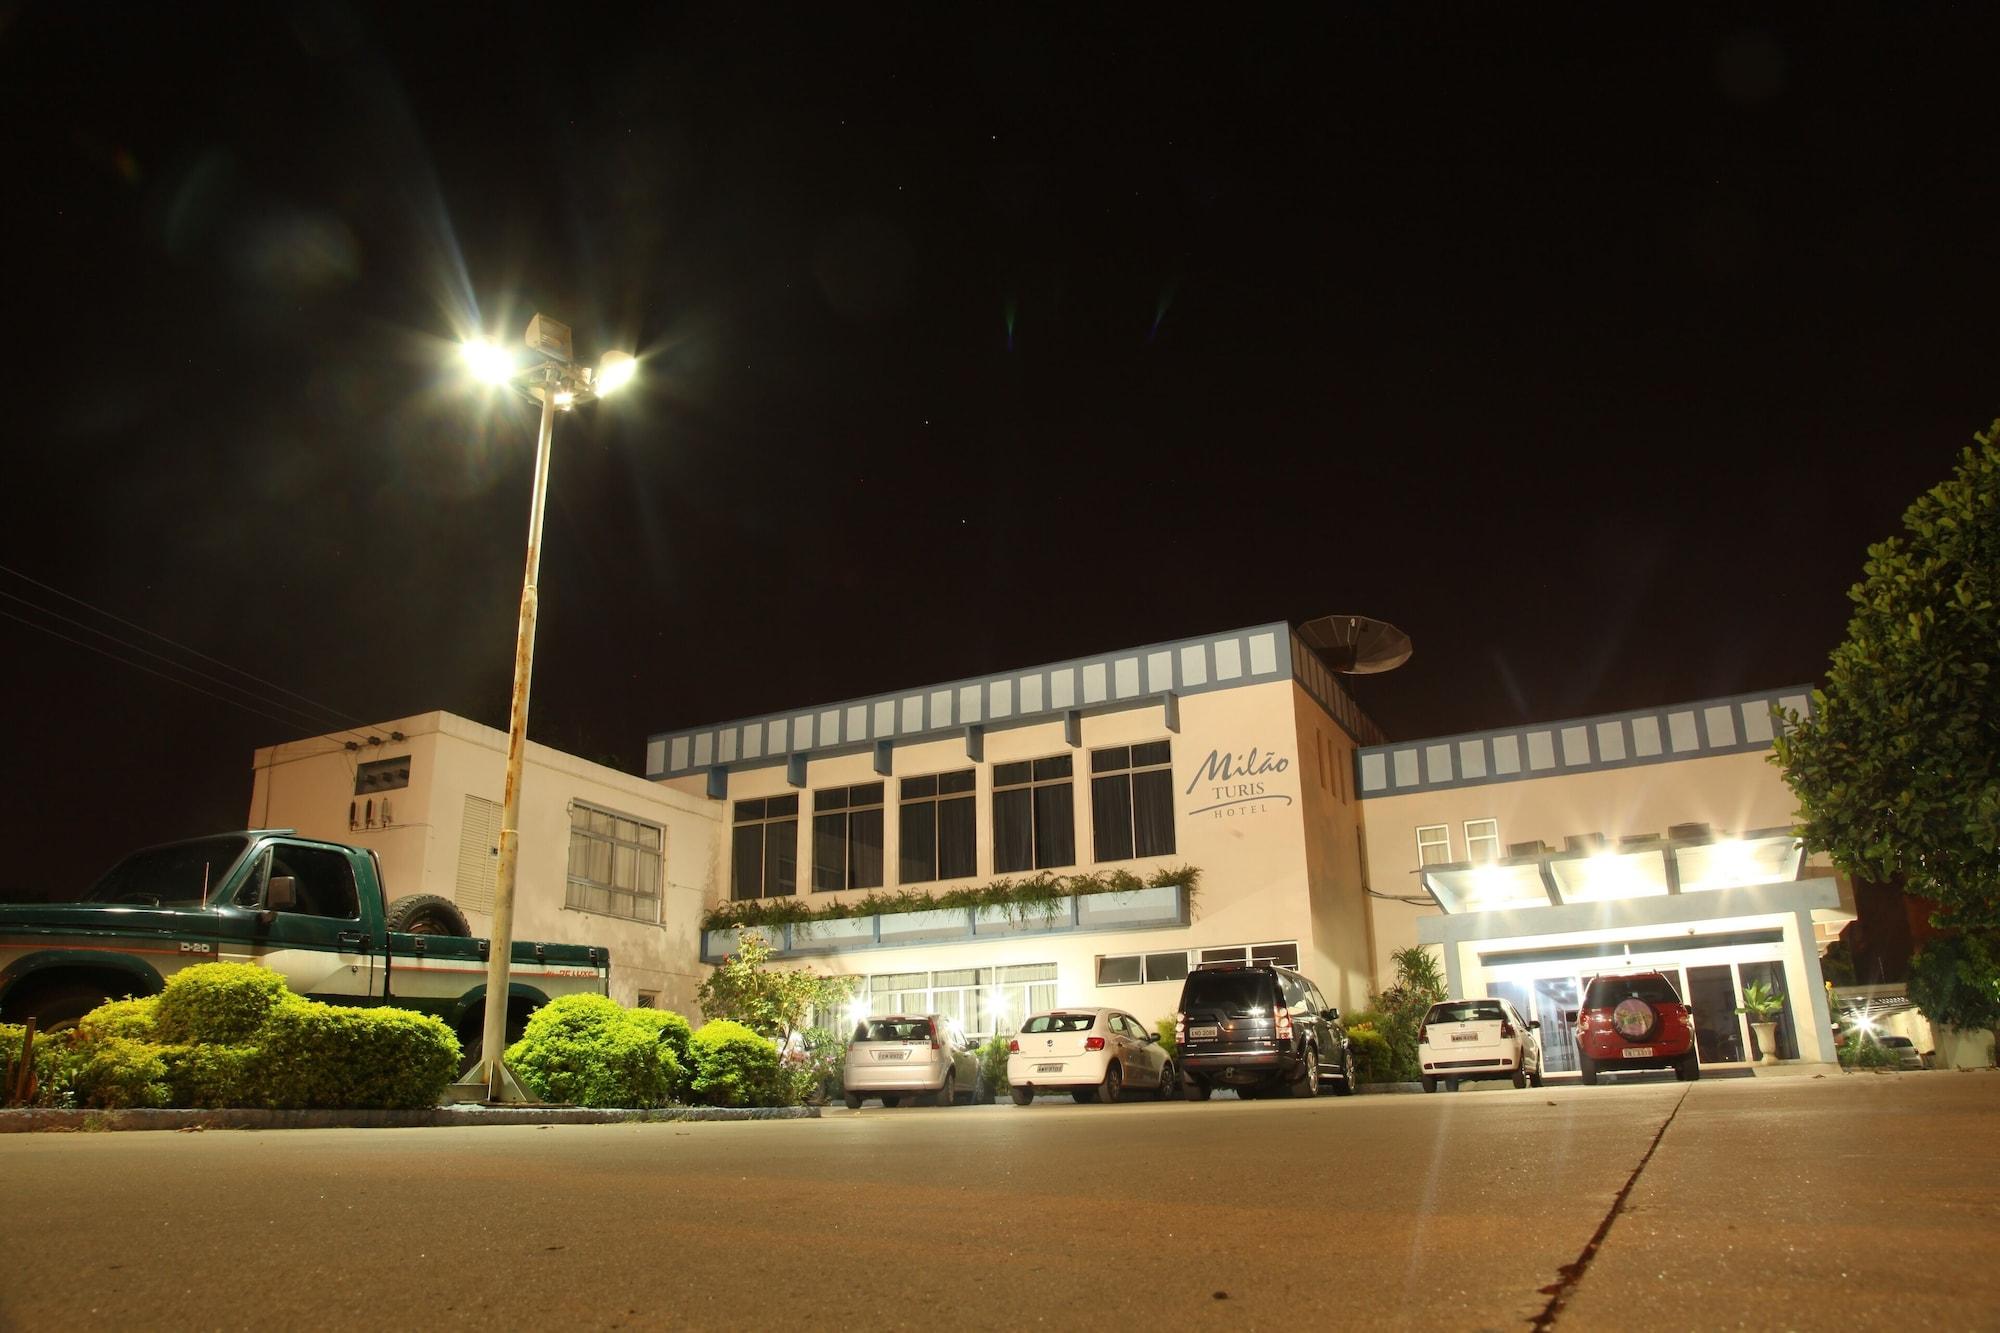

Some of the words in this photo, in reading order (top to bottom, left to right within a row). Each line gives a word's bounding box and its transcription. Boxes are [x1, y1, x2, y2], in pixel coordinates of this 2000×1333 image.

[1186, 747, 1289, 795] Milão
[1212, 782, 1265, 800] TURIS
[1214, 804, 1267, 819] HOTEL
[180, 942, 210, 953] D-20
